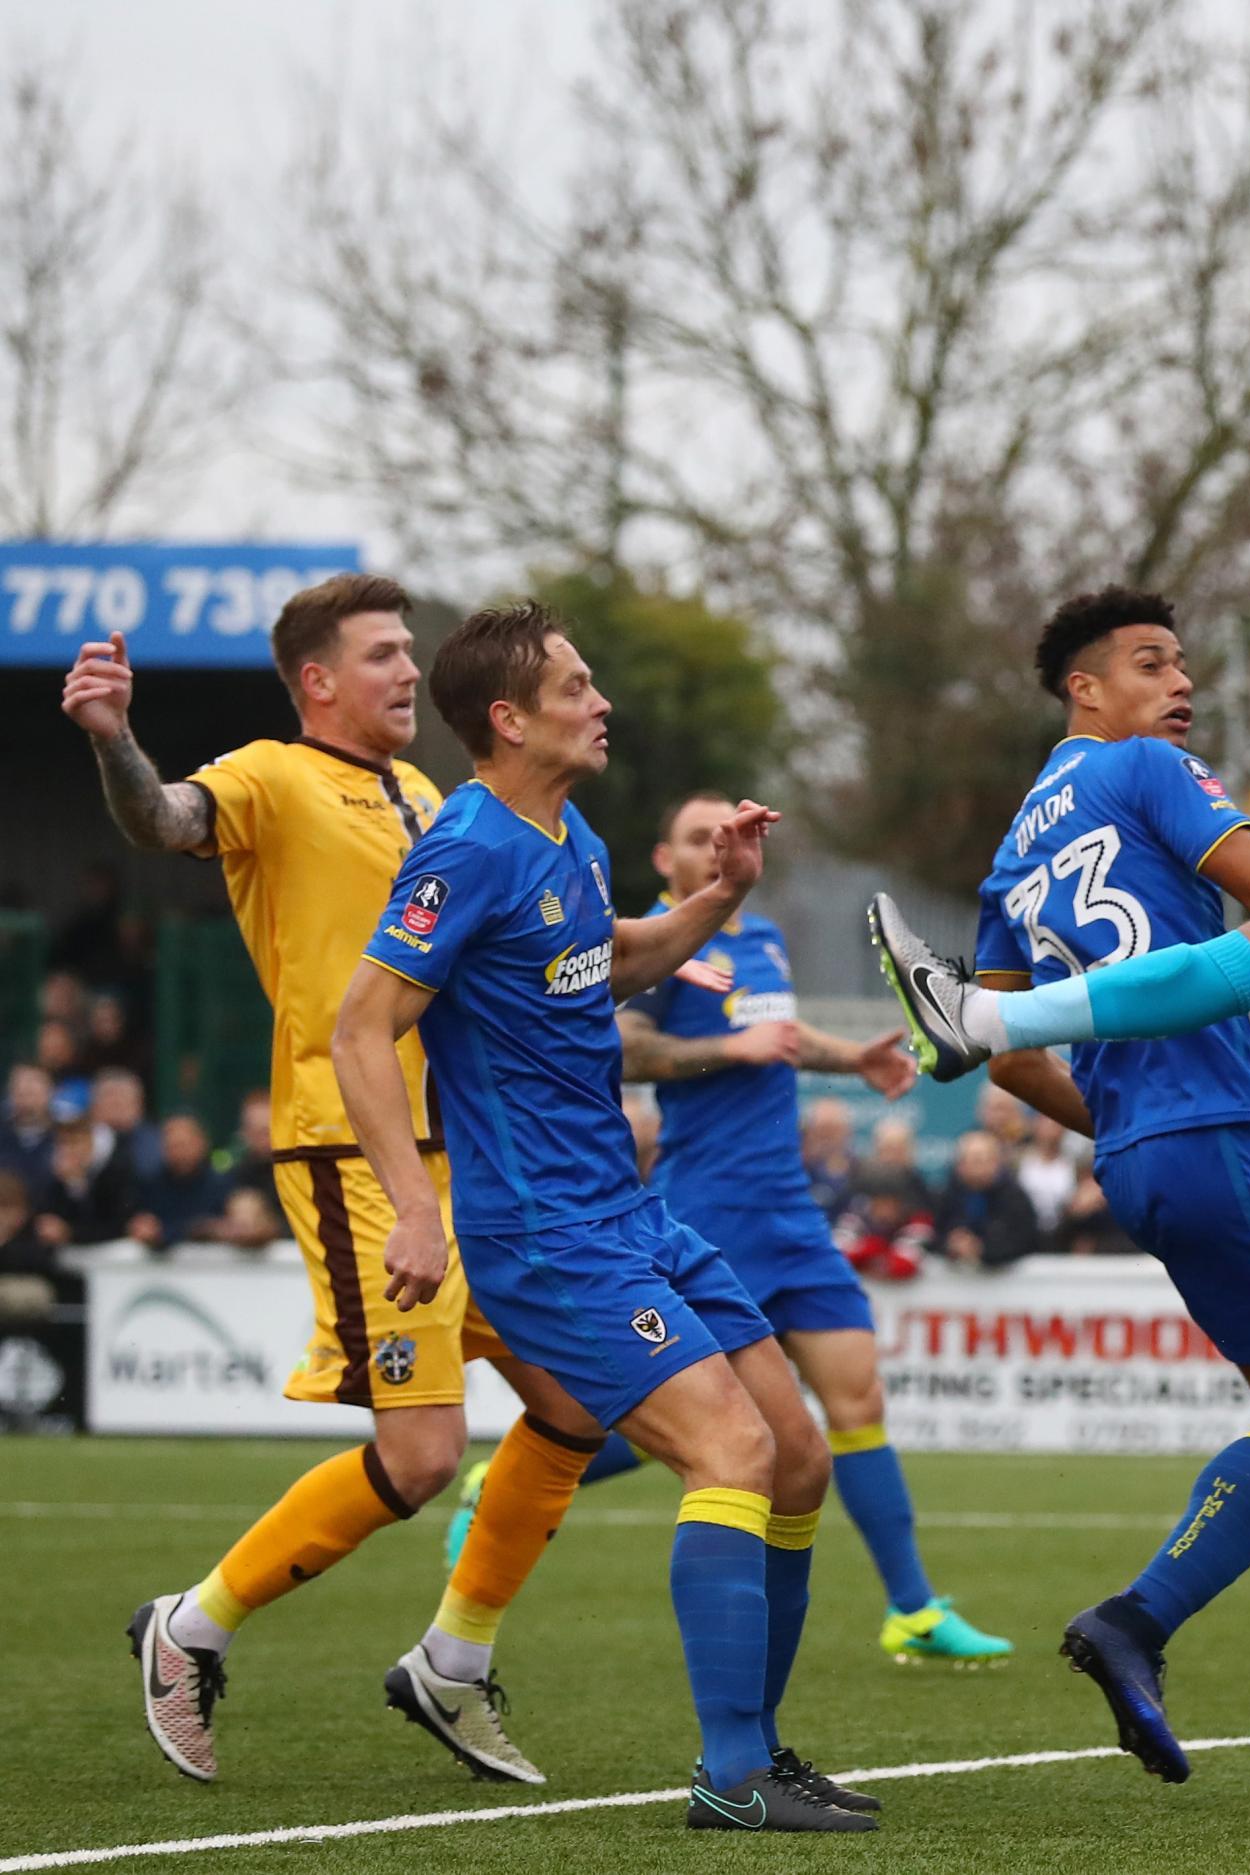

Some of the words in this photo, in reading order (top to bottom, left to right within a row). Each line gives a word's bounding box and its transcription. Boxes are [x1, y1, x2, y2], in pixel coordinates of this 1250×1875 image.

[4, 566, 148, 635] 770
[1014, 784, 1077, 859] TAYLOR
[1004, 824, 1152, 977] 33
[383, 924, 433, 954] Admiral
[1167, 1476, 1237, 1560] WIMBLEDON
